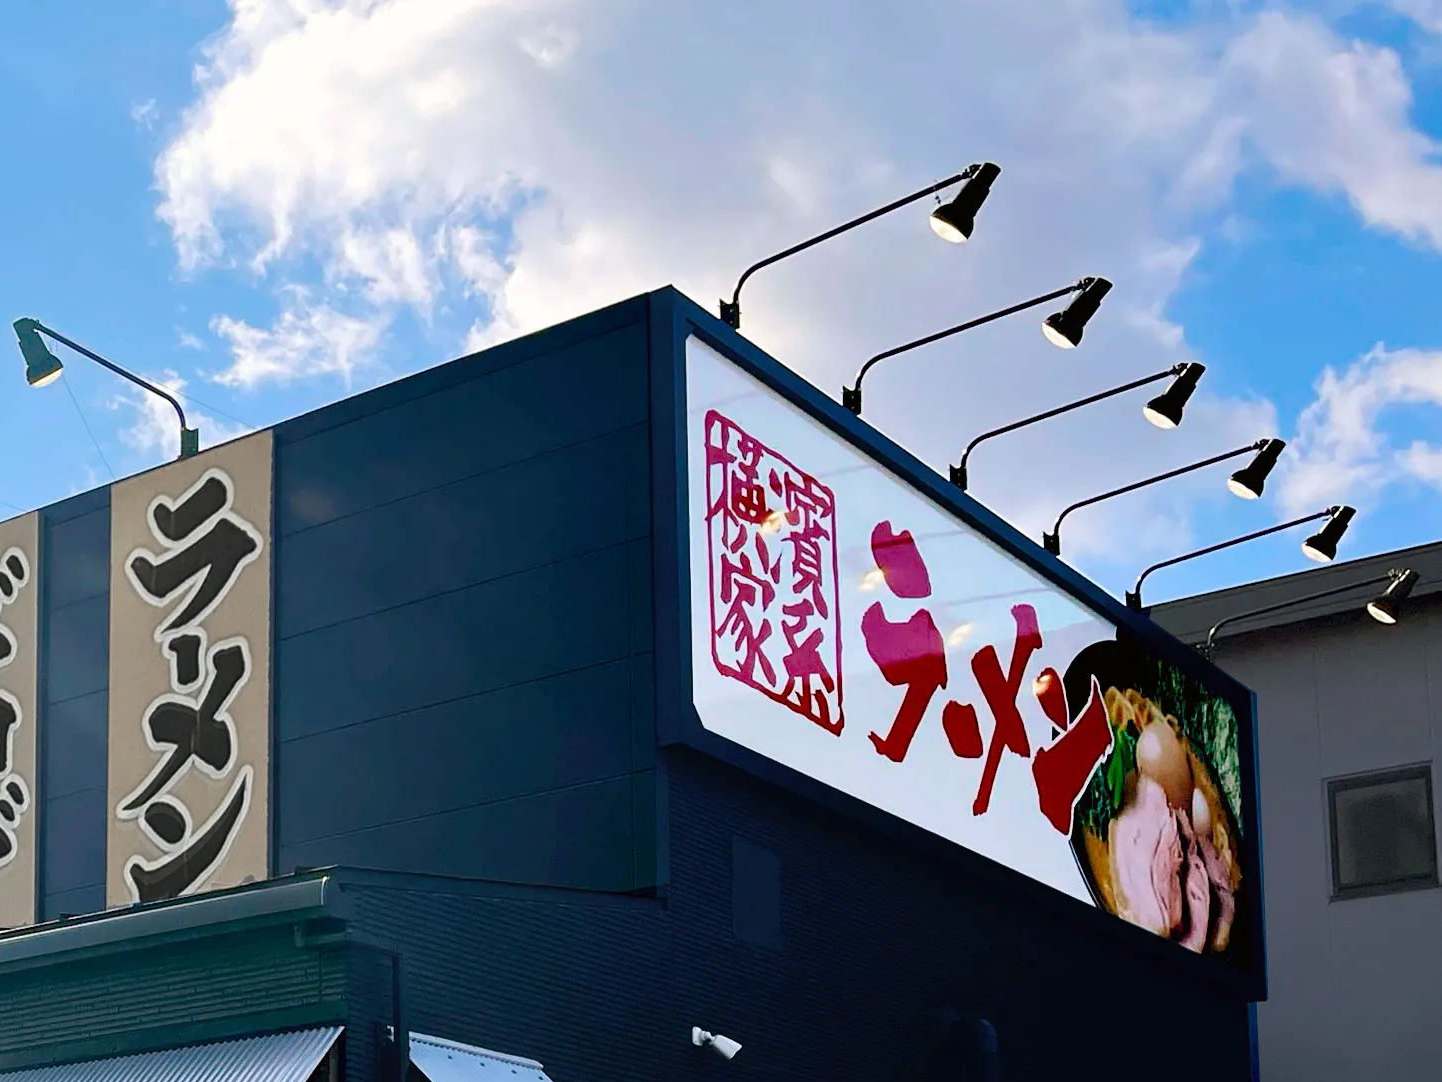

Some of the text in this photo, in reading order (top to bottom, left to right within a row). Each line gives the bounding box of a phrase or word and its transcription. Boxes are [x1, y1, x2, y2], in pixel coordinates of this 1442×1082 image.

[116, 468, 264, 903] ラーメン
[860, 518, 1116, 836] ラーメン
